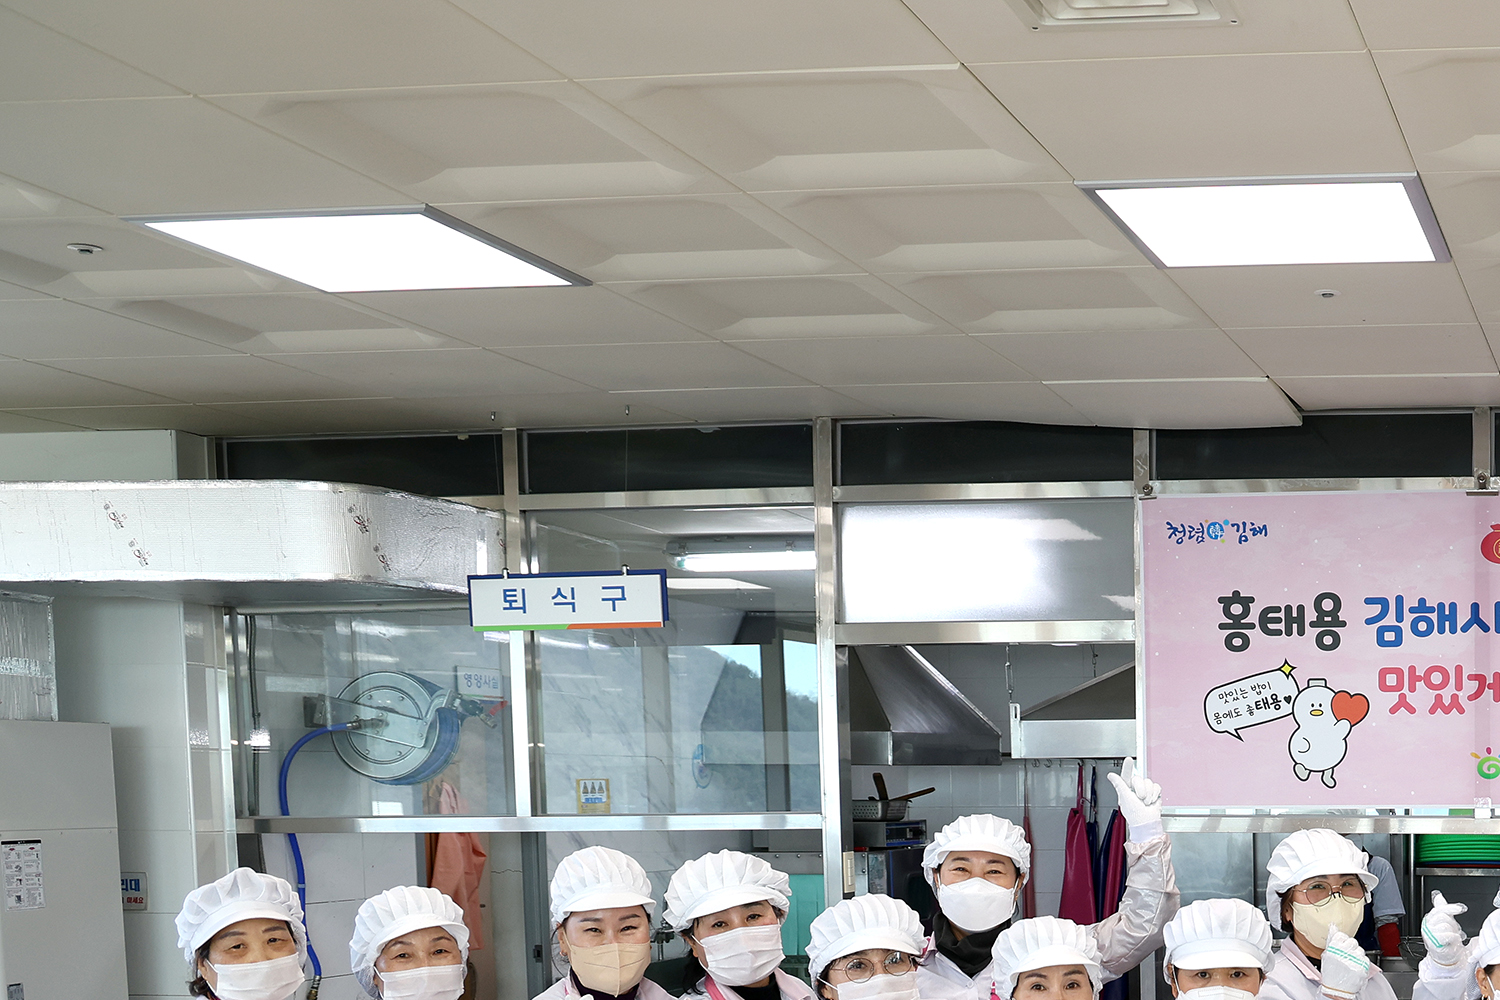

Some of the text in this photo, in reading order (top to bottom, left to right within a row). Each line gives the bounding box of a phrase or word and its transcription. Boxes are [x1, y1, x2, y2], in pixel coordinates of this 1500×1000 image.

[1230, 520, 1269, 545] 김해
[1217, 590, 1348, 652] 홍태용
[1218, 681, 1272, 704] 맛있는 밥이
[1213, 707, 1243, 725] 몸에도
